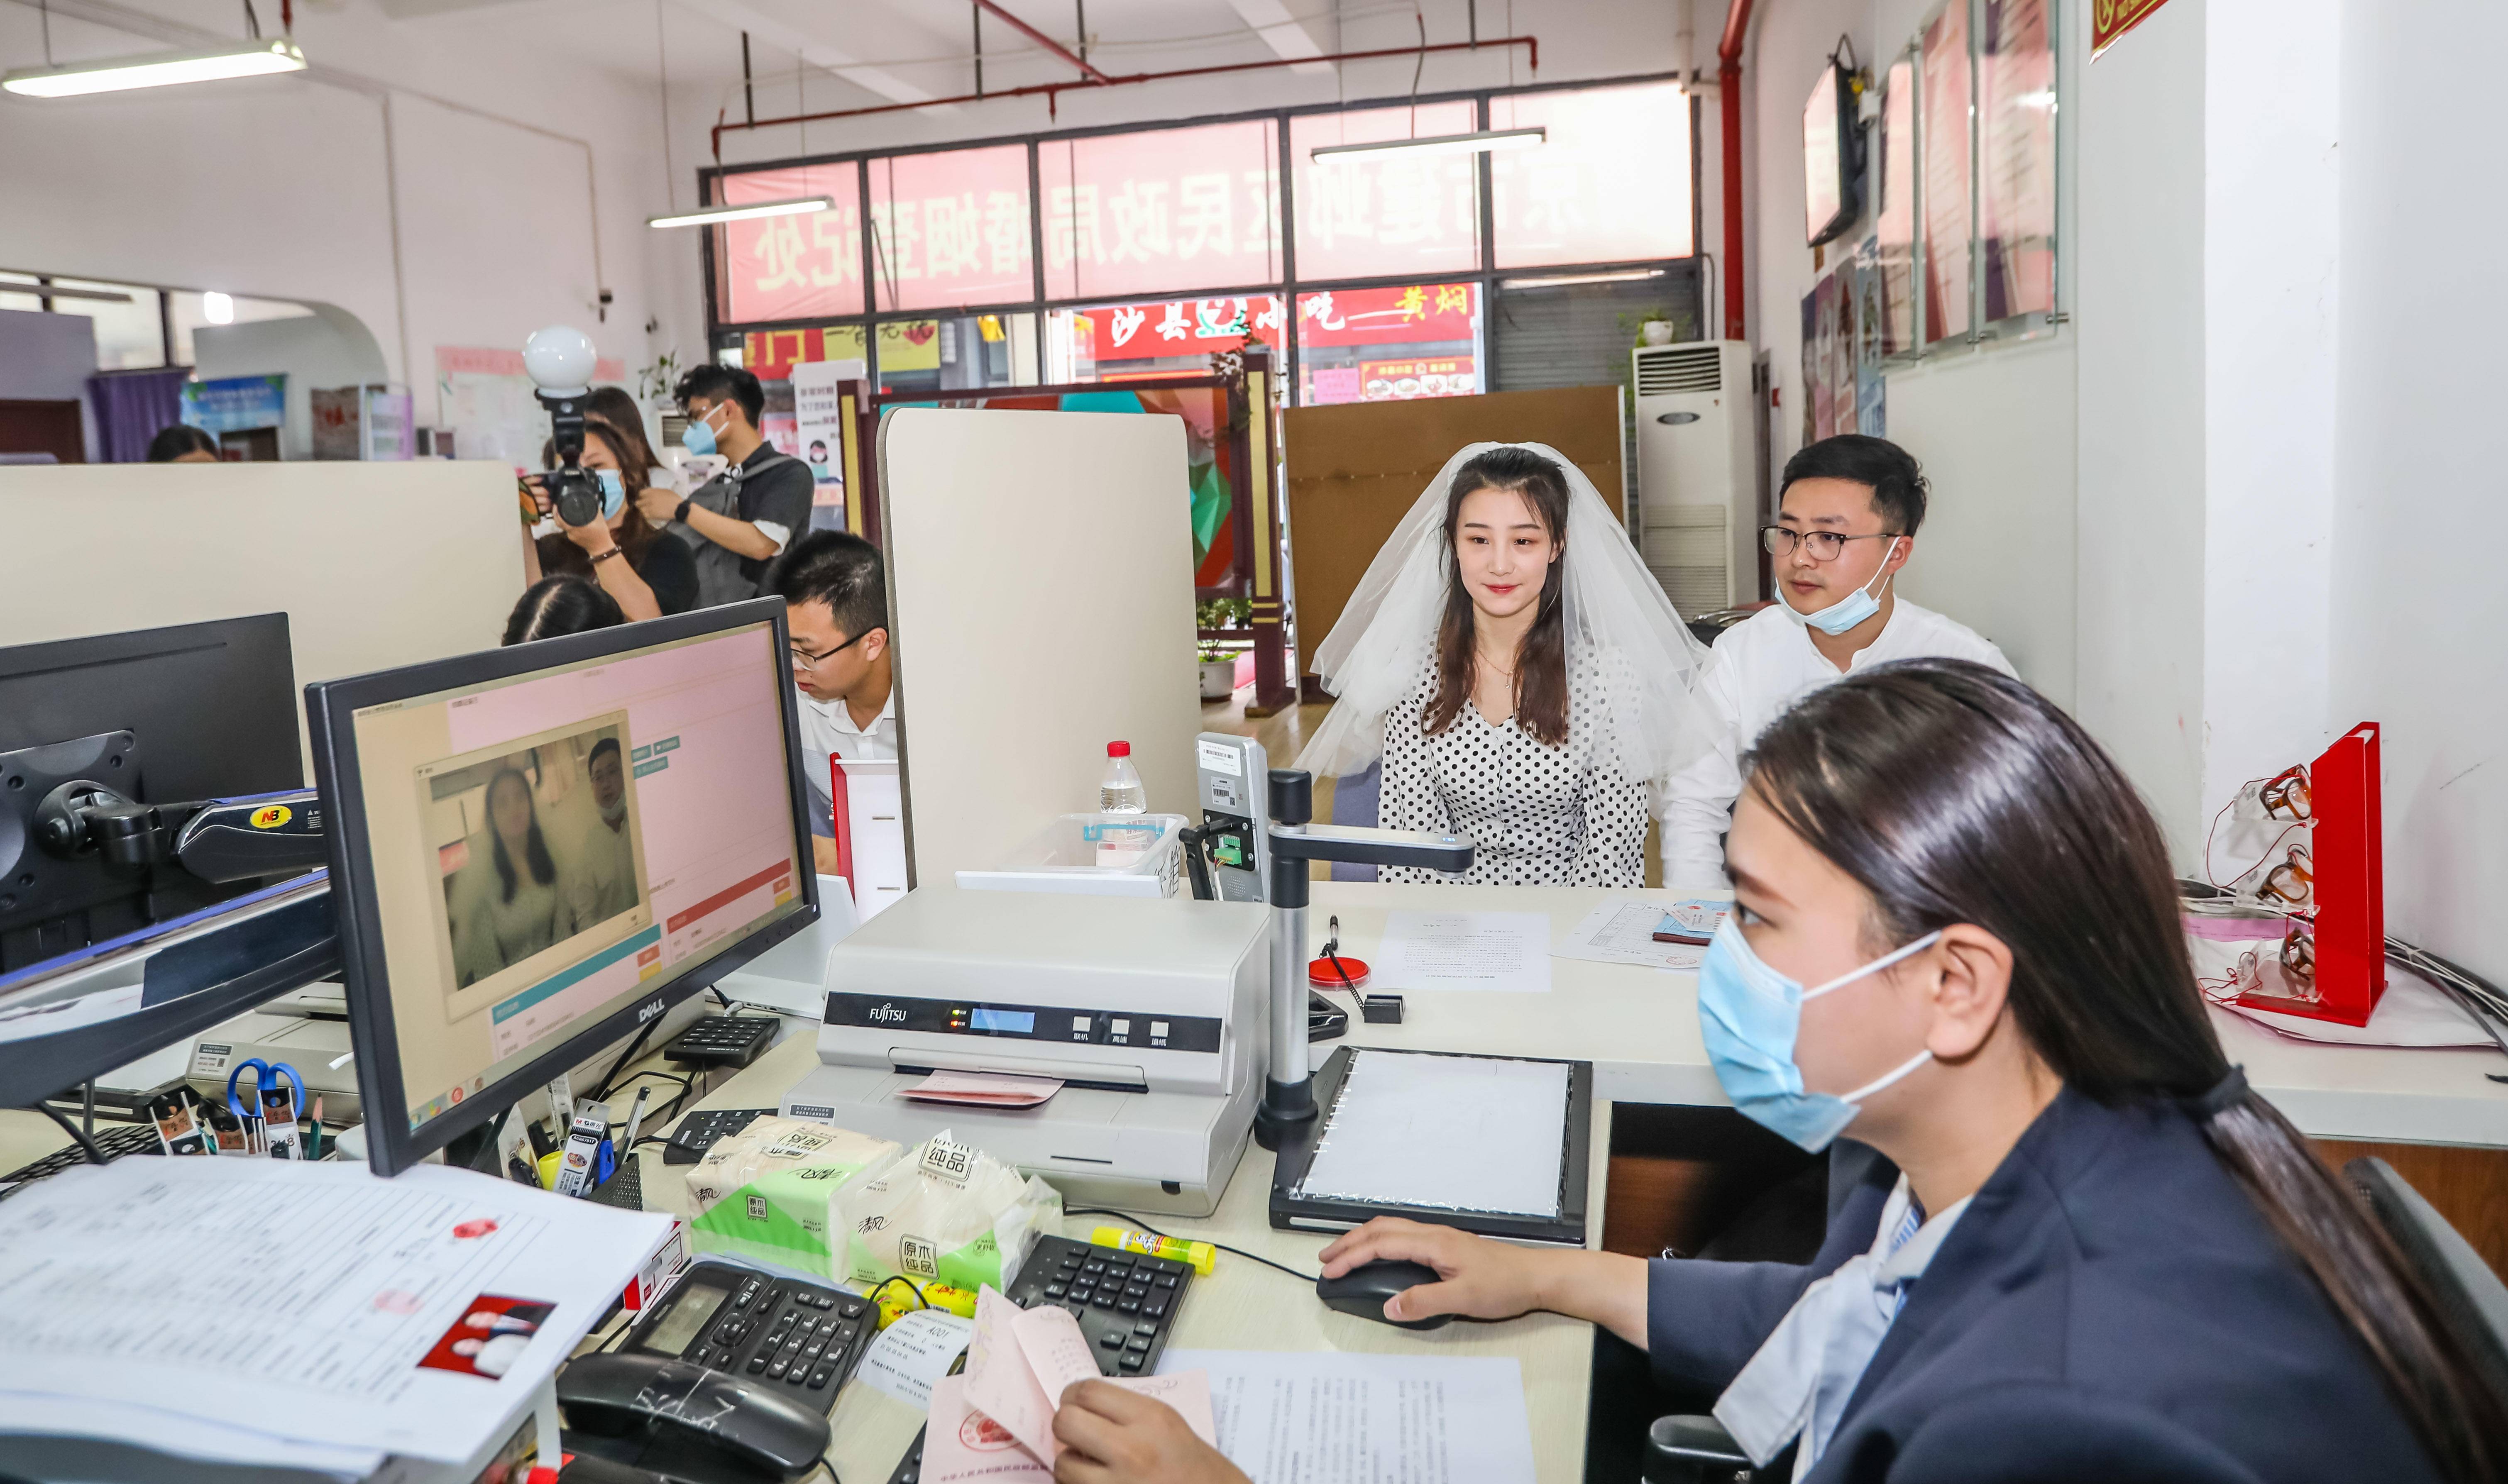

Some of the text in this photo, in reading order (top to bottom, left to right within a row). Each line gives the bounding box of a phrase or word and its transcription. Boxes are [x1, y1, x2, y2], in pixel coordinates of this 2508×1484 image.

[1394, 285, 1468, 323] 黄焖
[262, 810, 280, 823] NB
[639, 998, 665, 1023] DELL
[869, 1003, 907, 1023] FUJITSU
[1112, 1035, 1127, 1044] 高速
[927, 1147, 966, 1172] 纯品
[695, 1188, 721, 1203] 清风
[749, 1197, 764, 1207] 原木
[750, 1206, 766, 1216] 纯品
[858, 1216, 892, 1235] 清风
[904, 1241, 931, 1259] 原木
[906, 1257, 934, 1274] 纯品
[926, 1326, 950, 1339] A001
